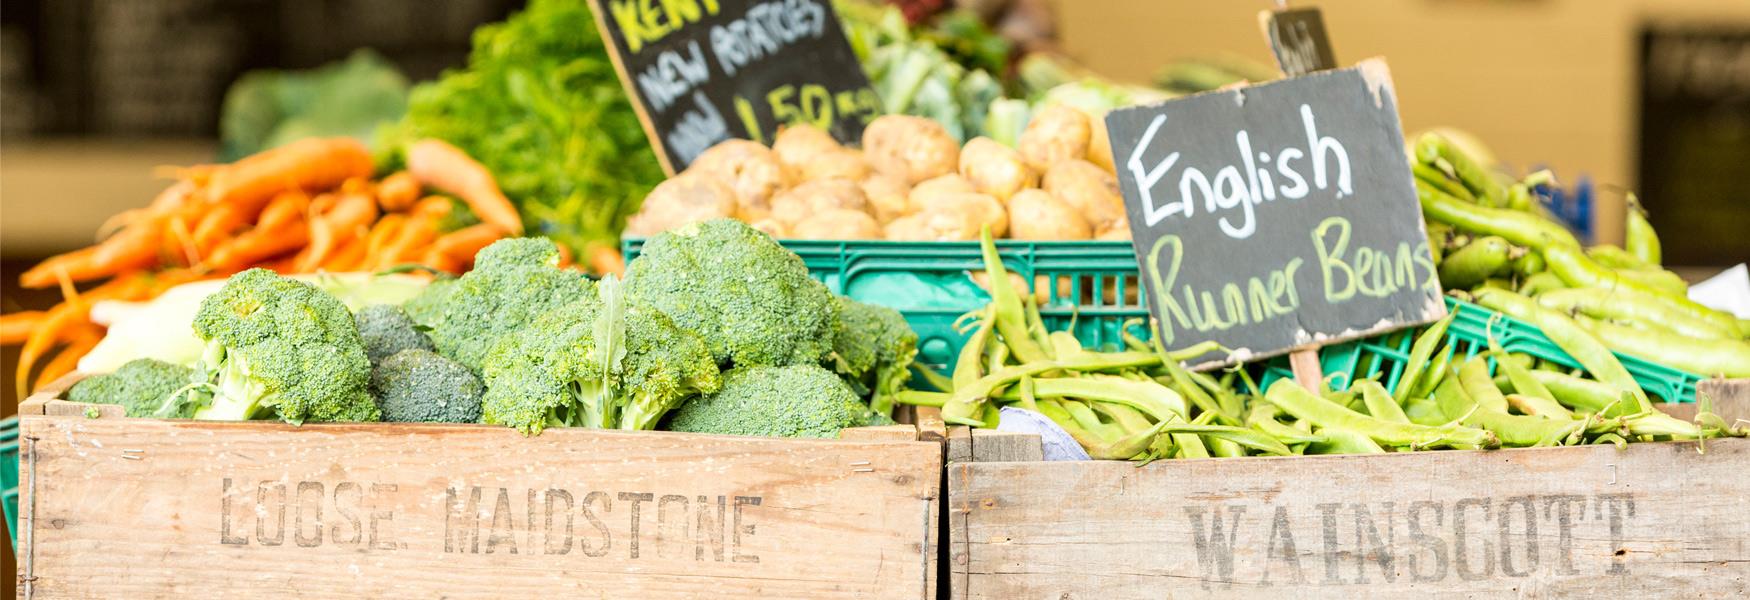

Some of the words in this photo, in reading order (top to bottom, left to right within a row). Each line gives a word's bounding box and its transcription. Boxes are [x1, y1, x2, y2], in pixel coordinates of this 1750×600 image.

[638, 39, 710, 112] NEW
[1127, 104, 1353, 239] English
[1147, 234, 1304, 345] Runner
[1312, 216, 1436, 303] Beans
[444, 486, 762, 563] MAIDSTONE
[1184, 491, 1636, 591] WAINSCOTT
